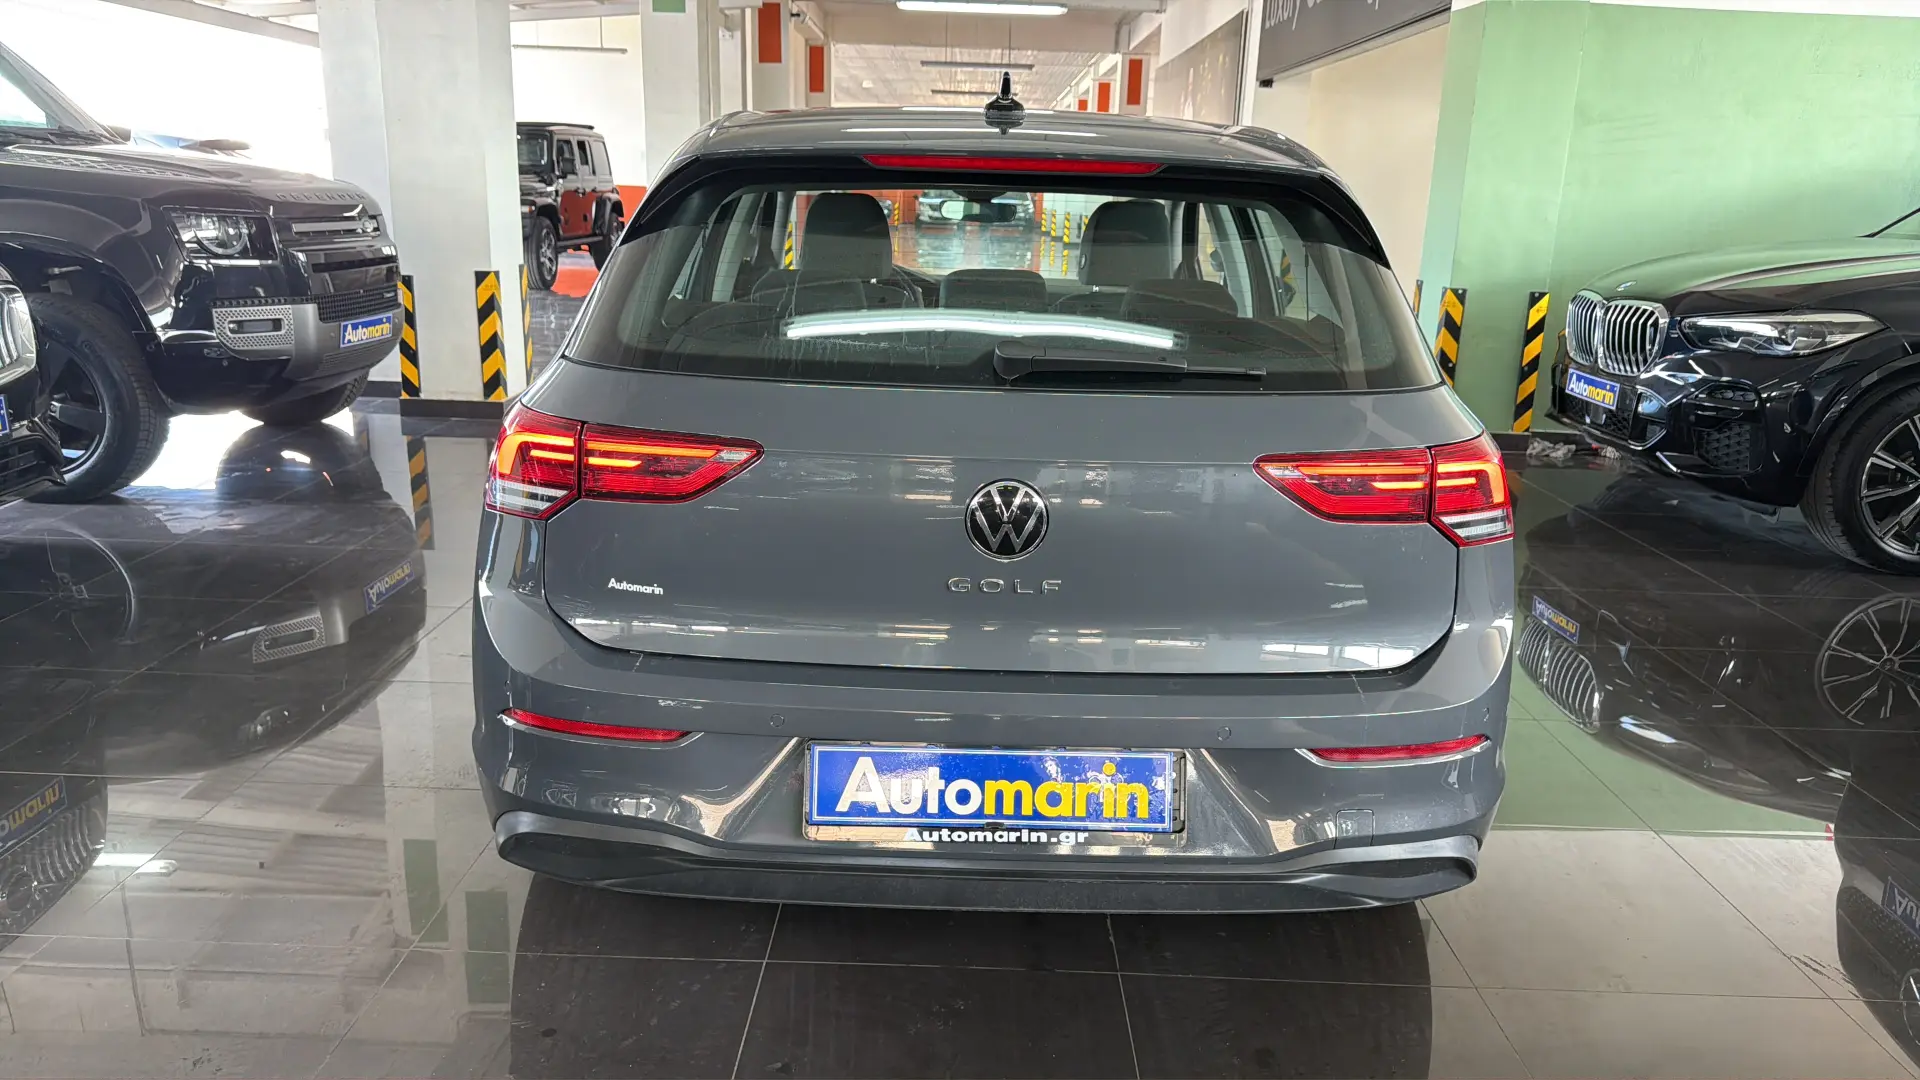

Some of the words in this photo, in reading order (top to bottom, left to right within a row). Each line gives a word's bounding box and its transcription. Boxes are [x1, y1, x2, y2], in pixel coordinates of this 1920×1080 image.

[343, 317, 391, 344] Automarin
[1568, 373, 1615, 406] Automarin
[607, 577, 664, 595] Automarin
[947, 577, 1062, 594] GOLF
[834, 756, 1149, 819] Automarin
[903, 828, 1089, 846] Automarin.gr
